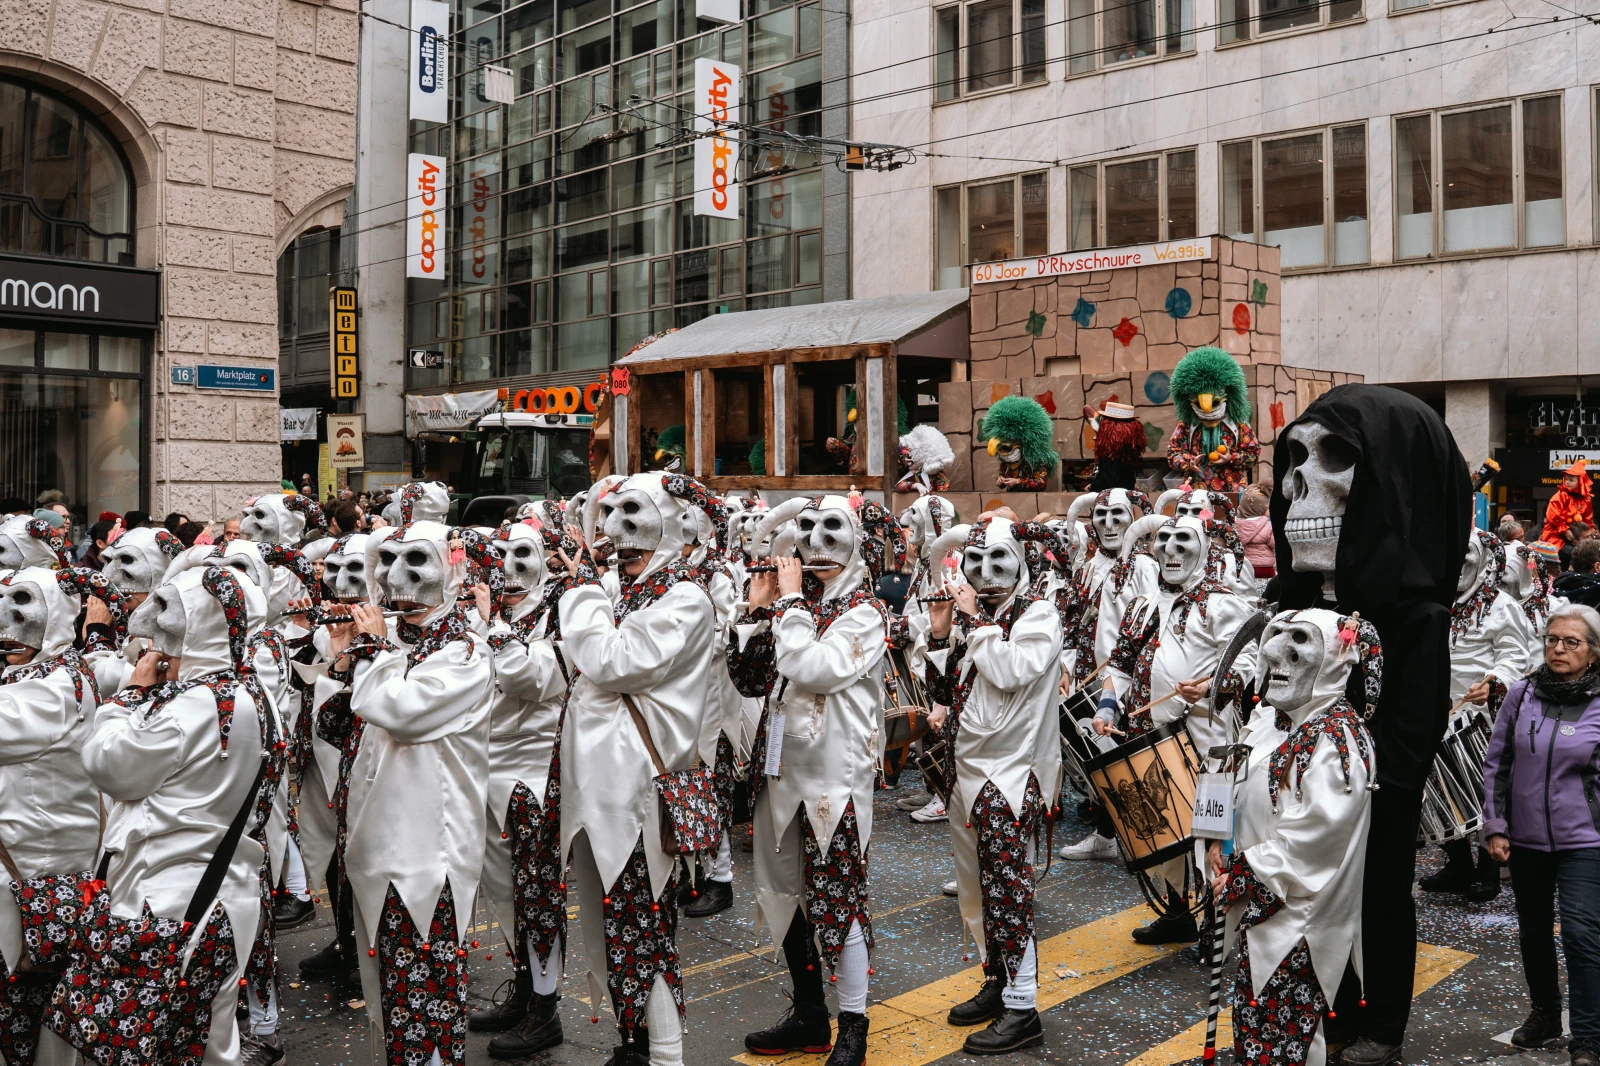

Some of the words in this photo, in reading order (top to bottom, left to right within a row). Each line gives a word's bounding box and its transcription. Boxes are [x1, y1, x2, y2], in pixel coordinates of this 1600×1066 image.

[421, 32, 434, 87] Berlitz
[708, 67, 732, 124] city
[418, 159, 440, 206] city
[712, 130, 732, 211] coop
[421, 209, 439, 273] coop
[975, 264, 992, 281] 60
[995, 264, 1027, 279] Joor
[1037, 252, 1141, 275] D'Rhyschnuure
[1153, 243, 1205, 261] Waggis
[1, 279, 100, 313] mann
[339, 294, 353, 394] metro
[177, 370, 189, 381] 16
[216, 369, 256, 382] Marktplatz
[614, 380, 627, 388] 080
[513, 385, 580, 414] coop
[1205, 799, 1224, 818] Alte
[1002, 993, 1025, 1001] JAKO
